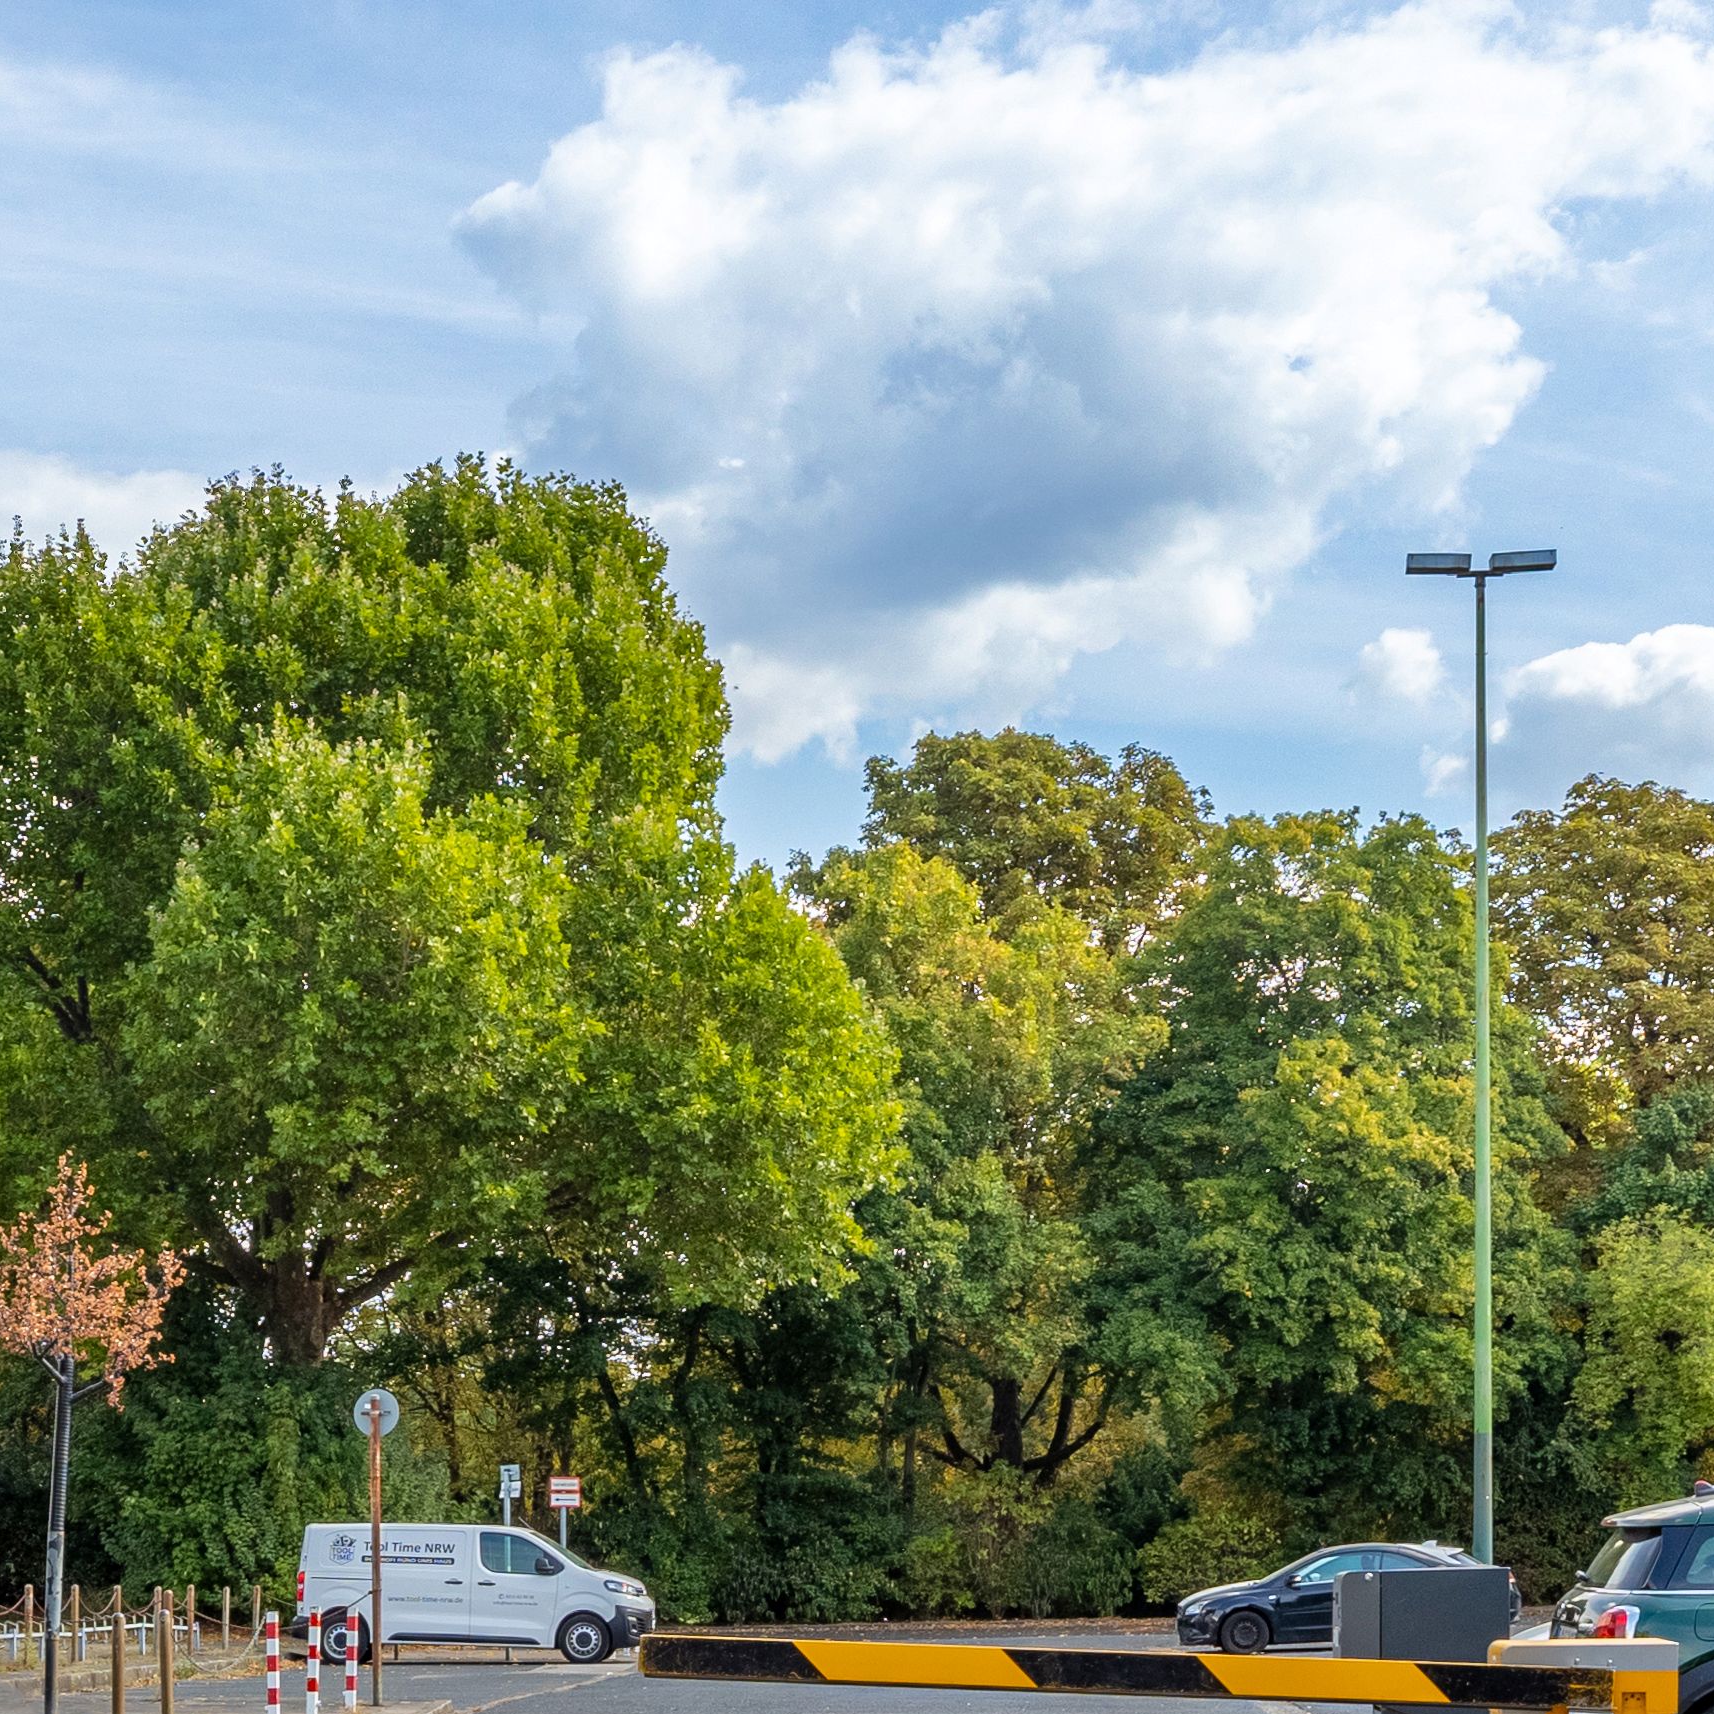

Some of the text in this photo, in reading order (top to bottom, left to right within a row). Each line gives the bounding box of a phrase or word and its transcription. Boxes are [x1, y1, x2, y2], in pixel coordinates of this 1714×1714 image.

[391, 1541, 422, 1553] Time
[424, 1543, 456, 1554] NRW
[332, 1553, 353, 1561] TIME
